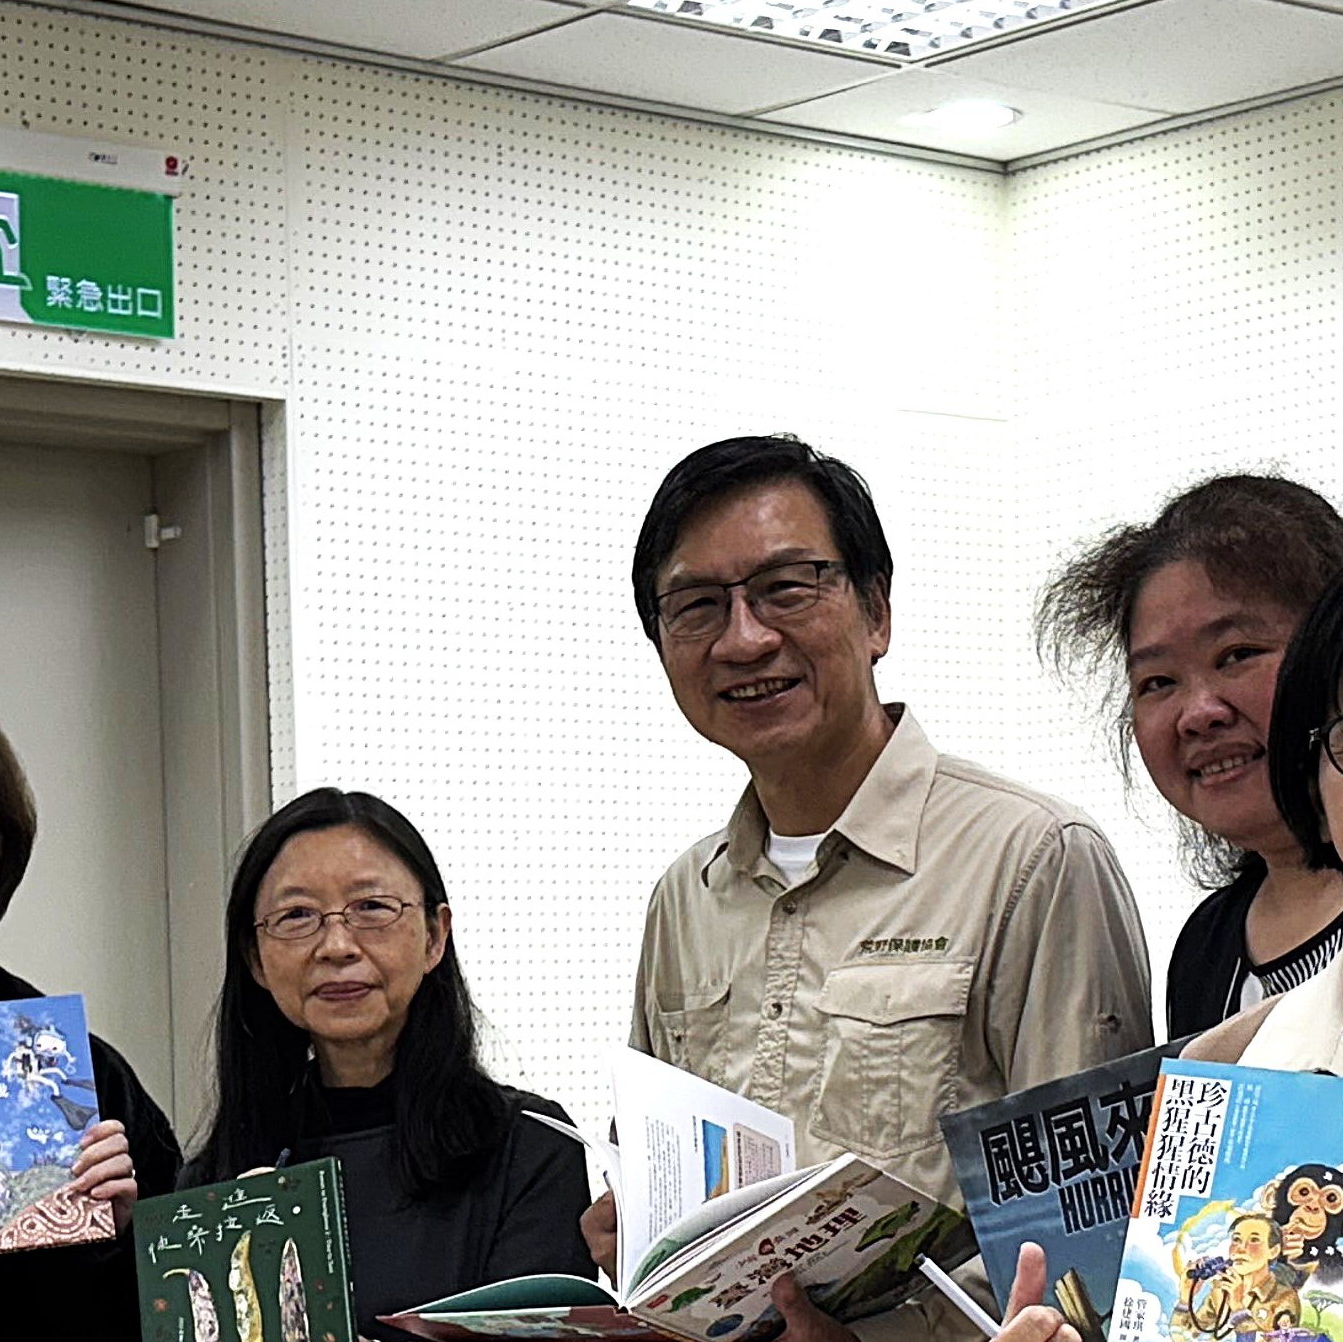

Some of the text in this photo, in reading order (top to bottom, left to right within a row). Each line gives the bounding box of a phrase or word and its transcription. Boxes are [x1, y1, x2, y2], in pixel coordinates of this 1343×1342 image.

[46, 275, 163, 319] 緊急出口
[1144, 1078, 1195, 1219] 黑猩猩情緣
[1180, 1081, 1227, 1195] 珍古德的
